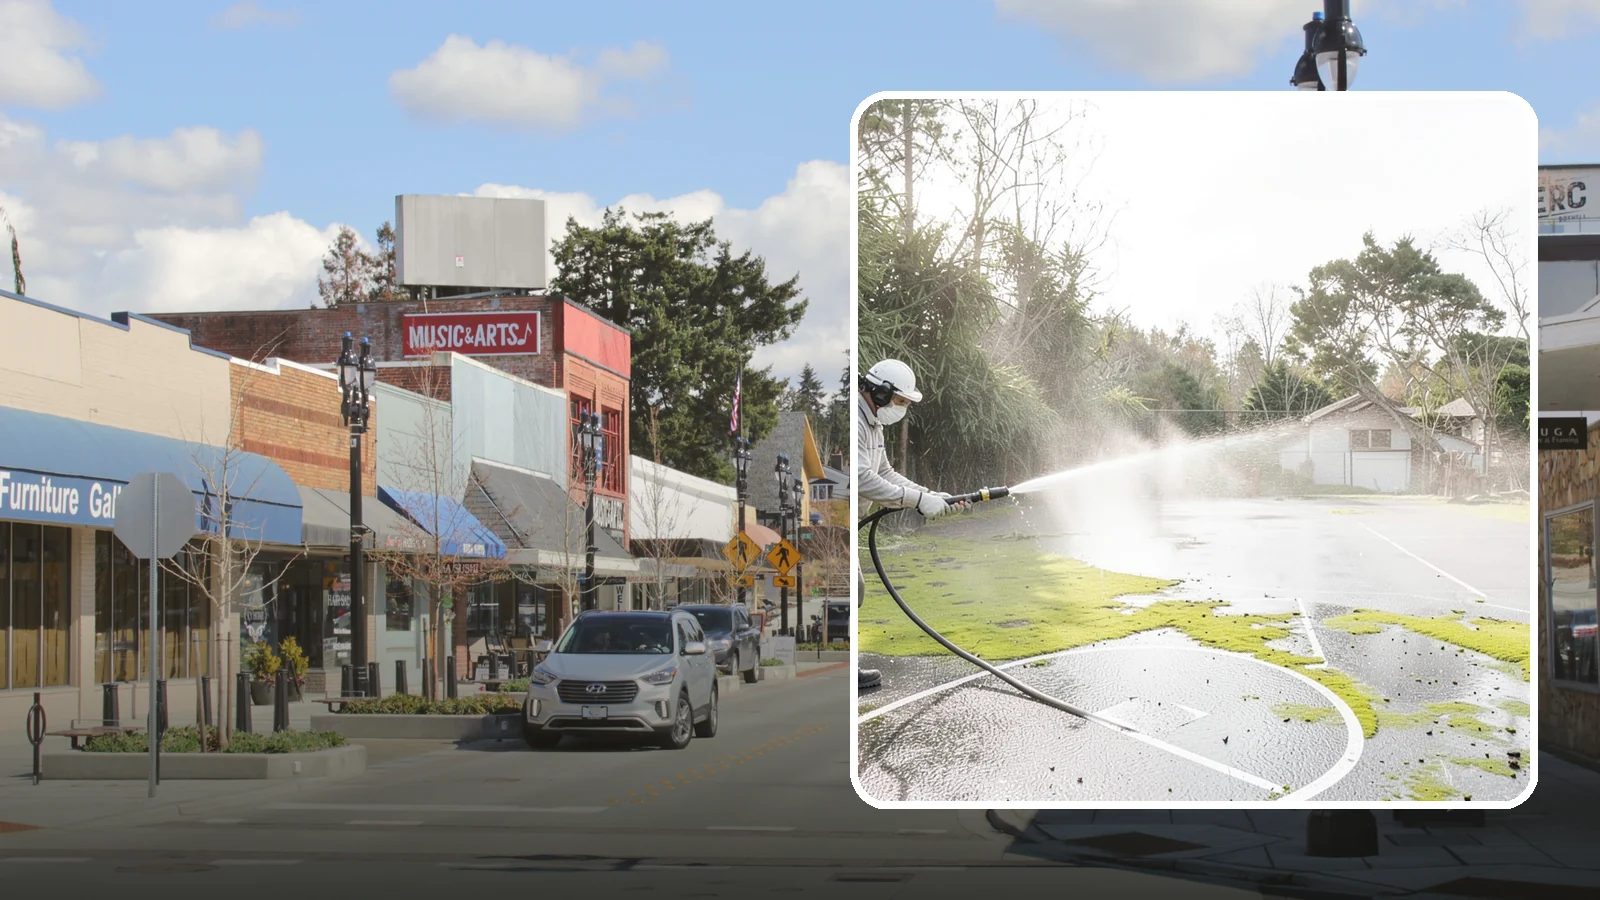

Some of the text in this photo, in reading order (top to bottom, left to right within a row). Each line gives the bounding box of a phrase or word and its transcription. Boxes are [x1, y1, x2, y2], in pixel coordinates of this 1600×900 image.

[408, 323, 520, 349] MUSIC&ARTS
[0, 471, 79, 515] Furniture
[453, 563, 480, 573] SUSHI
